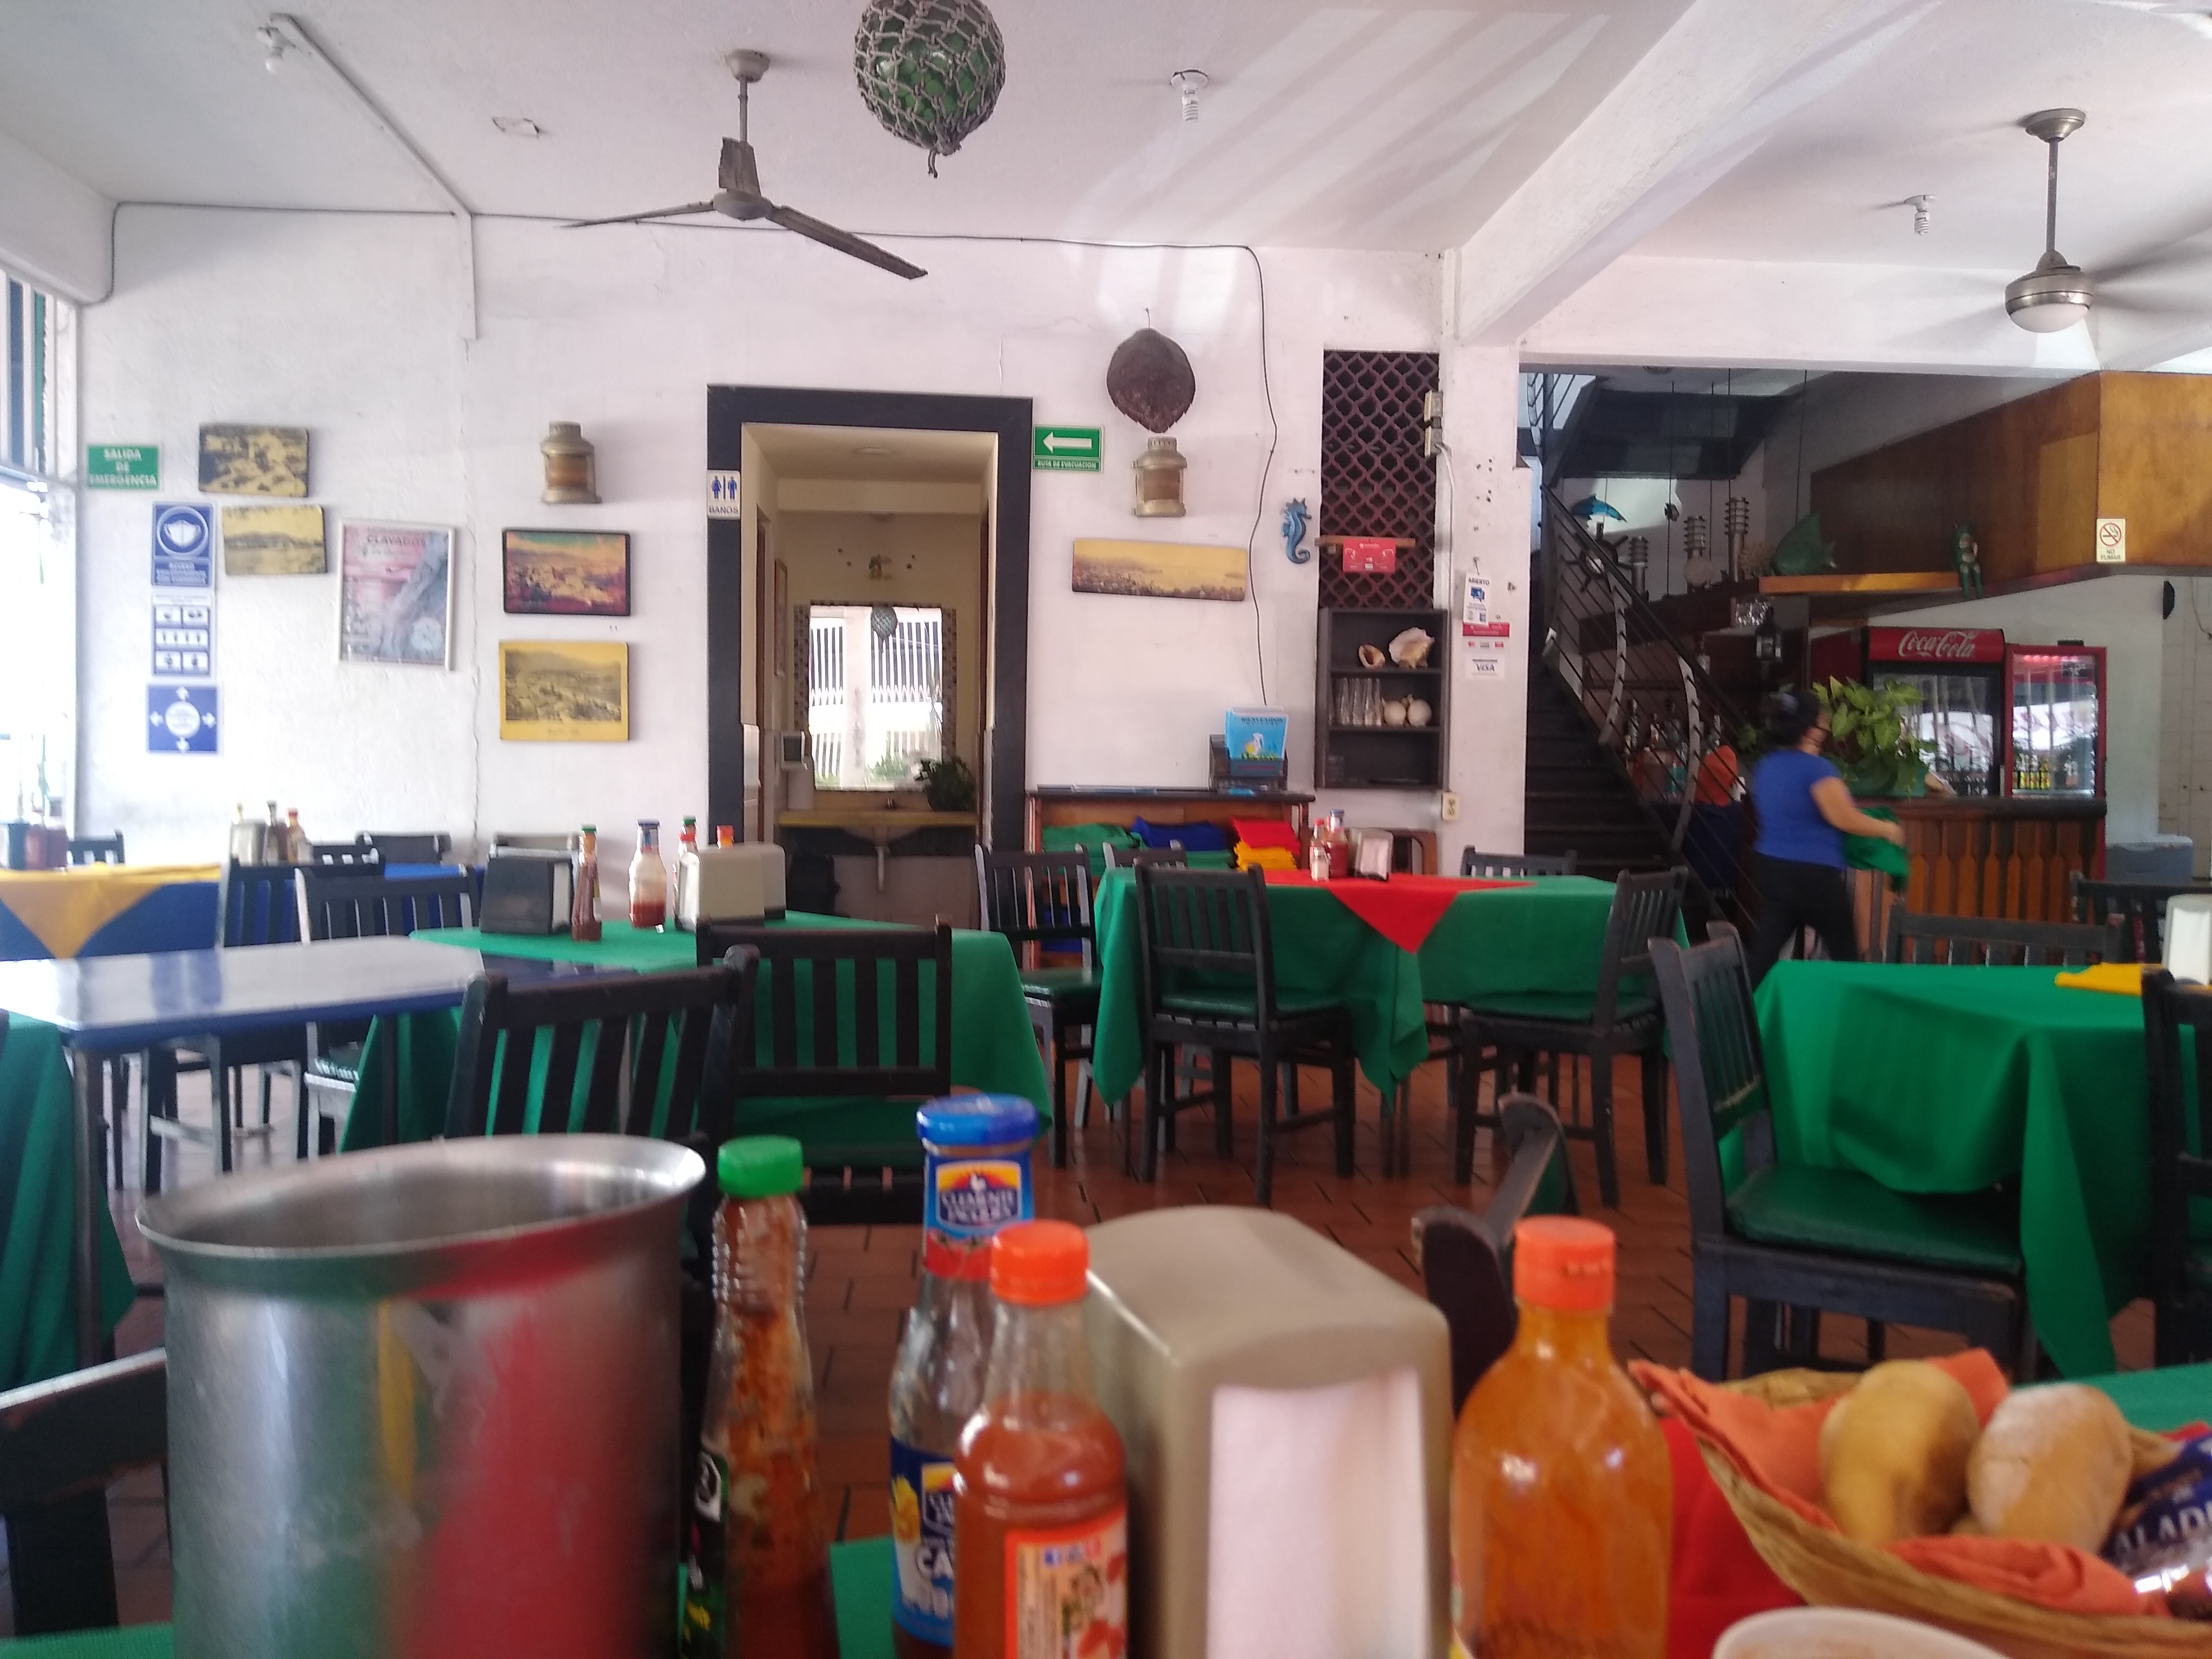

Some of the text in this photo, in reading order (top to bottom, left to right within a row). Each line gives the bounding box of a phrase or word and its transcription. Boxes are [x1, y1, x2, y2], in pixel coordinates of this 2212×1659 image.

[104, 448, 141, 461] SALIDA
[116, 461, 130, 474] DE
[1037, 460, 1052, 468] RUTA
[1476, 663, 1495, 671] VISA
